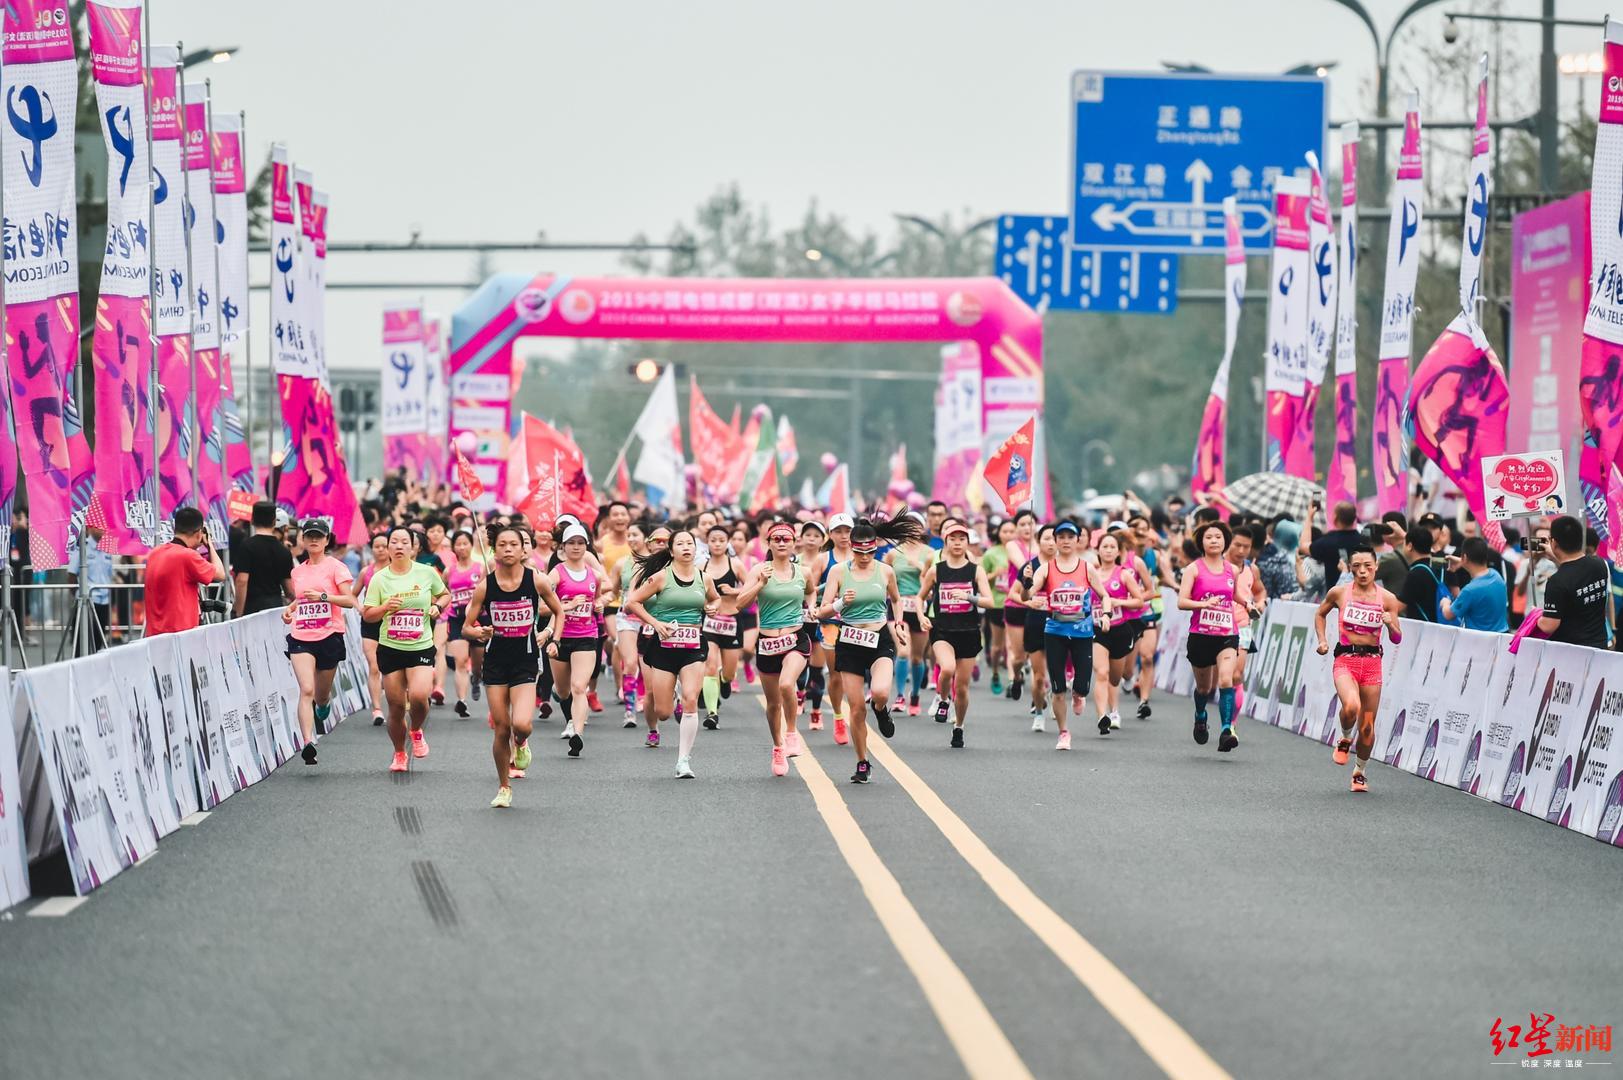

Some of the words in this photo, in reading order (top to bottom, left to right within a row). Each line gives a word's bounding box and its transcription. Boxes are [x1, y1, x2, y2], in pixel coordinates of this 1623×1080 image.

[299, 604, 328, 615] A2523
[1347, 608, 1382, 623] A2265
[390, 617, 421, 627] A2148
[494, 610, 531, 622] A2552
[1202, 611, 1231, 623] A0025
[671, 628, 697, 639] 2529
[844, 627, 876, 643] A2512
[761, 636, 793, 651] A2513
